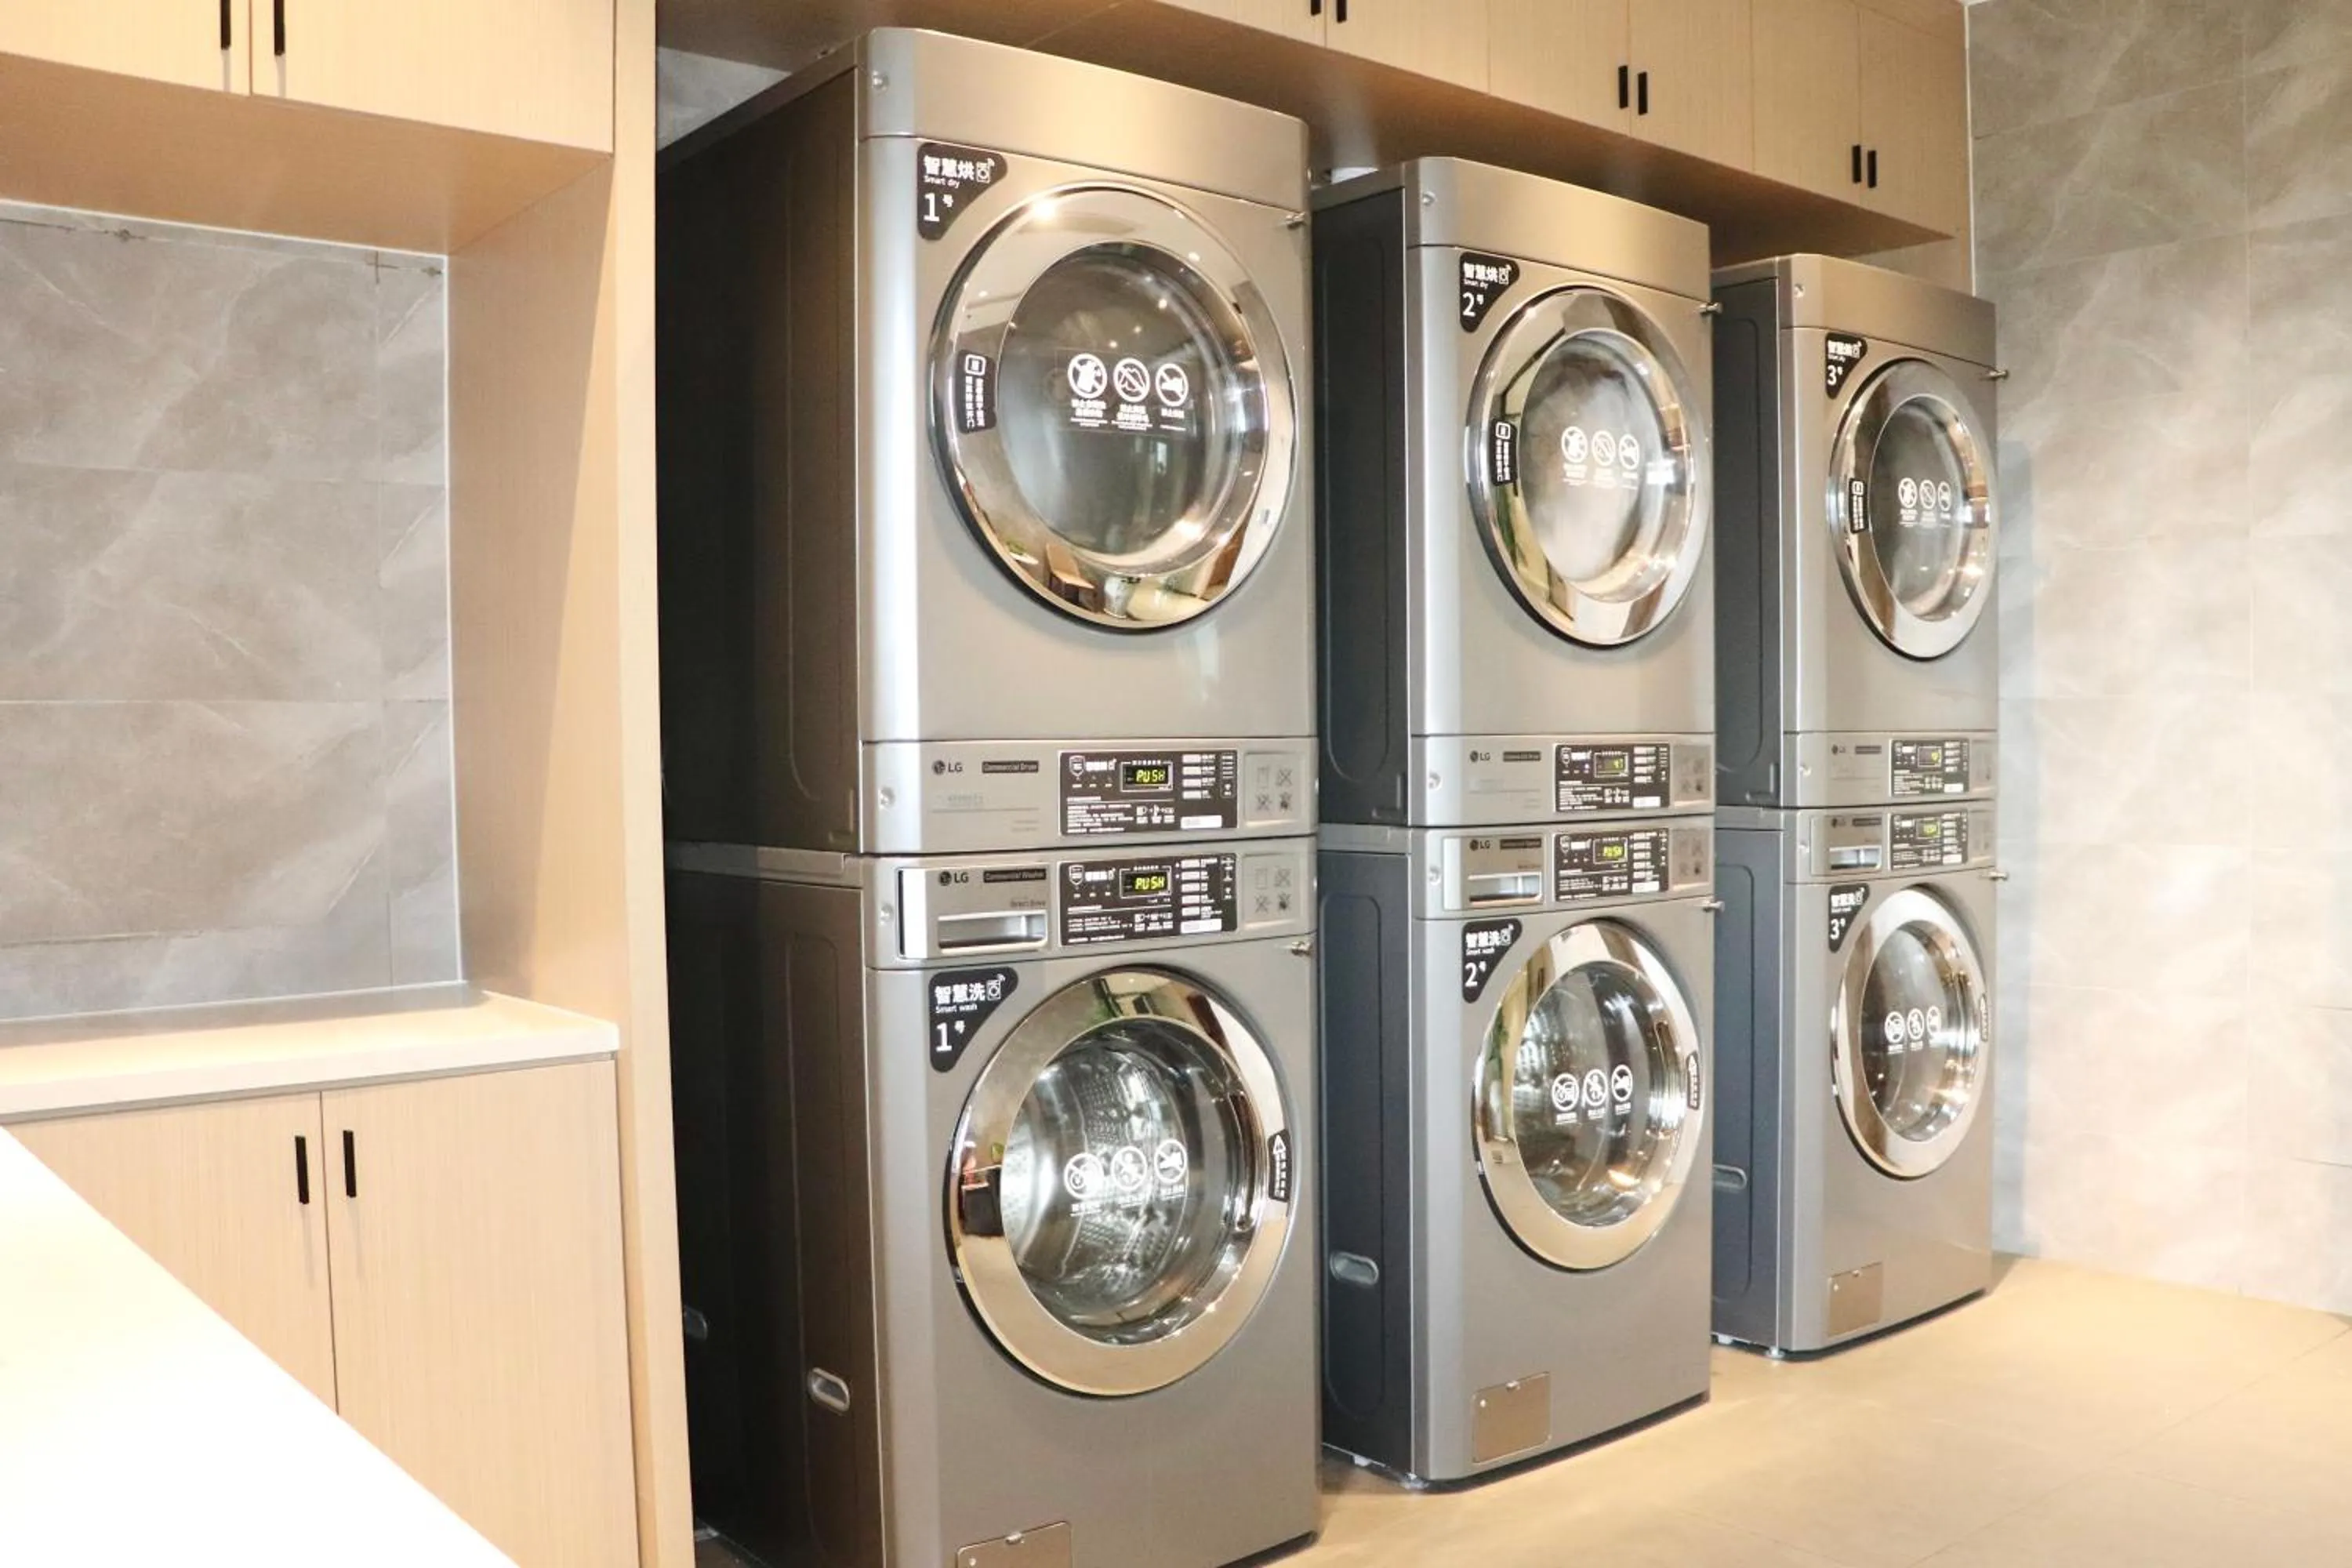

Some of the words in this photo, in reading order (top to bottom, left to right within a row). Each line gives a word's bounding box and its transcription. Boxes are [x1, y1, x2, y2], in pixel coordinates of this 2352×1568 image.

[1479, 752, 1490, 761] LG
[948, 762, 963, 773] LG
[1479, 840, 1490, 849] LG
[954, 872, 969, 883] LG
[1134, 876, 1166, 890] PUSH
